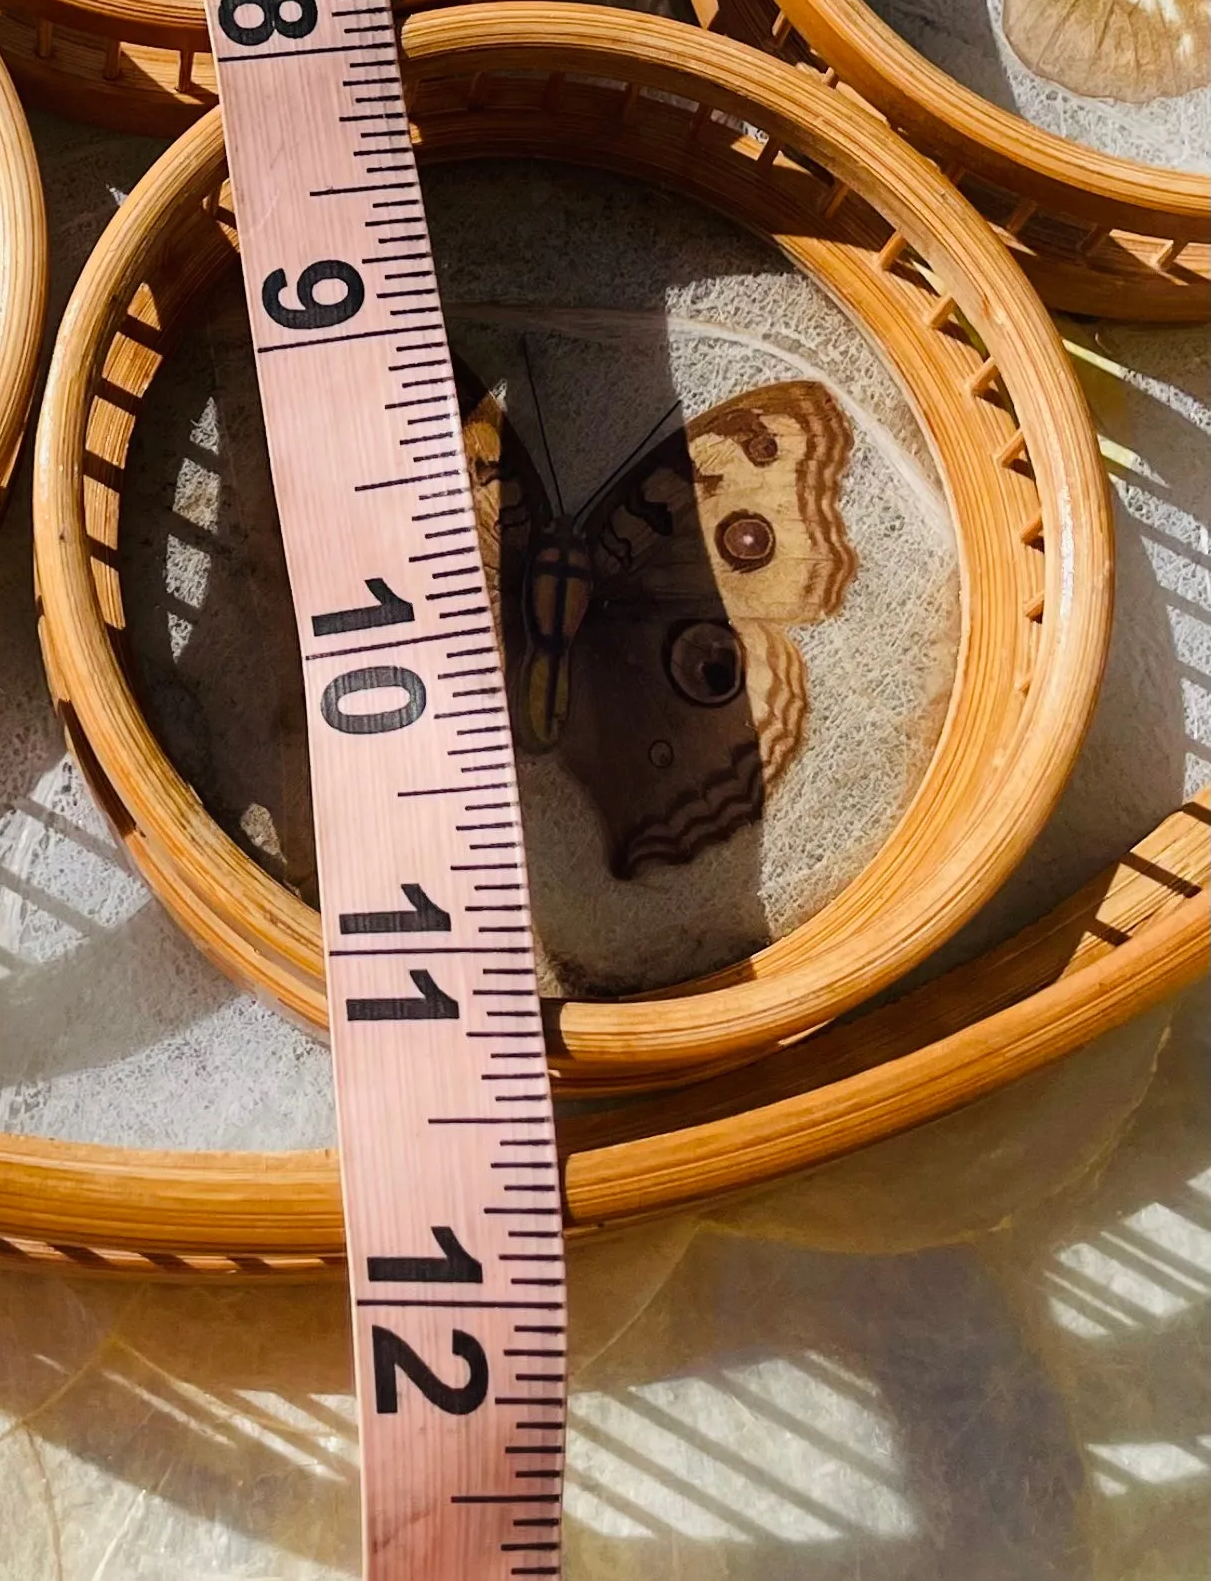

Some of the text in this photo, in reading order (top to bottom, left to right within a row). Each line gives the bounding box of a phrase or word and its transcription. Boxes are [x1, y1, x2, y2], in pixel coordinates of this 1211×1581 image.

[261, 259, 365, 330] 9
[311, 577, 427, 735] 10
[339, 883, 461, 1022] 11
[366, 1226, 489, 1415] 12
